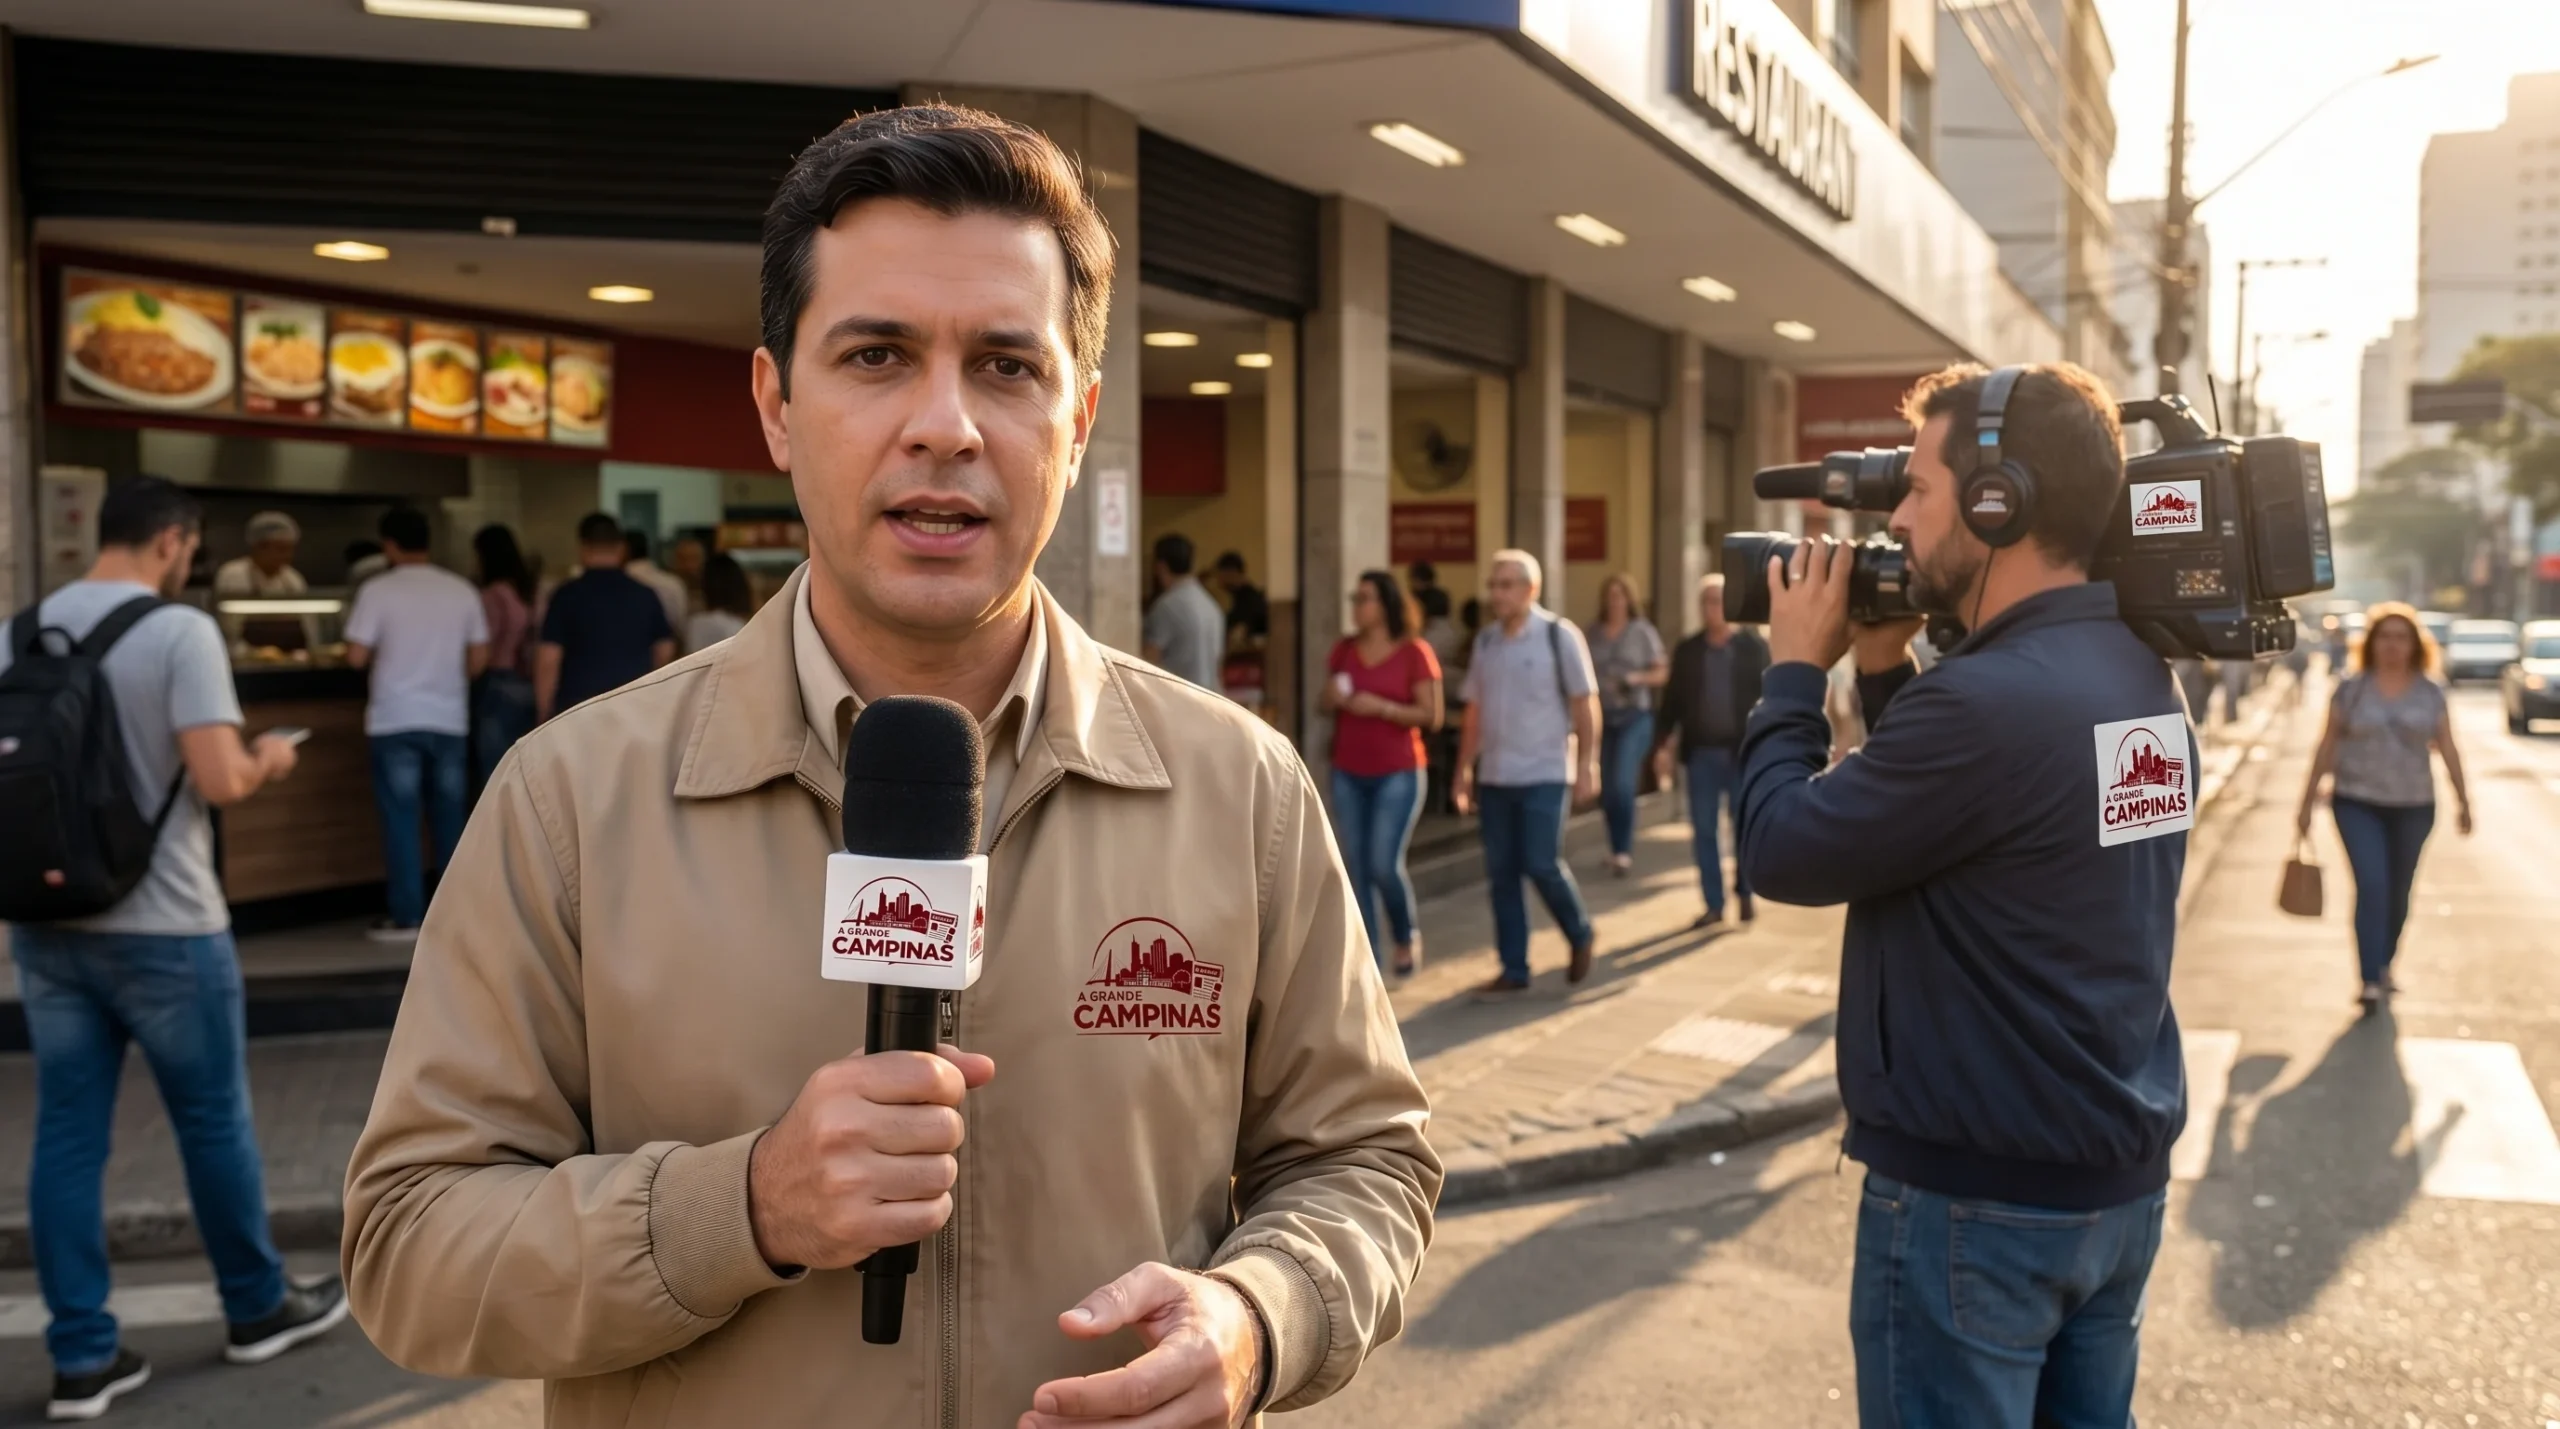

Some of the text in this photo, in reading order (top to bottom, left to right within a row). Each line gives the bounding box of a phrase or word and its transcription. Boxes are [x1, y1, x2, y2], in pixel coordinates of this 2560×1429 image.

[2136, 514, 2195, 526] CAMPINAS
[2105, 789, 2144, 803] A GRANDE
[2104, 793, 2186, 825] CAMPINAS
[838, 927, 890, 937] A GRANDE
[832, 937, 954, 961] CAMPINAS
[1077, 990, 1143, 1002] A GRANDE
[1073, 1003, 1221, 1029] CAMPINAS
